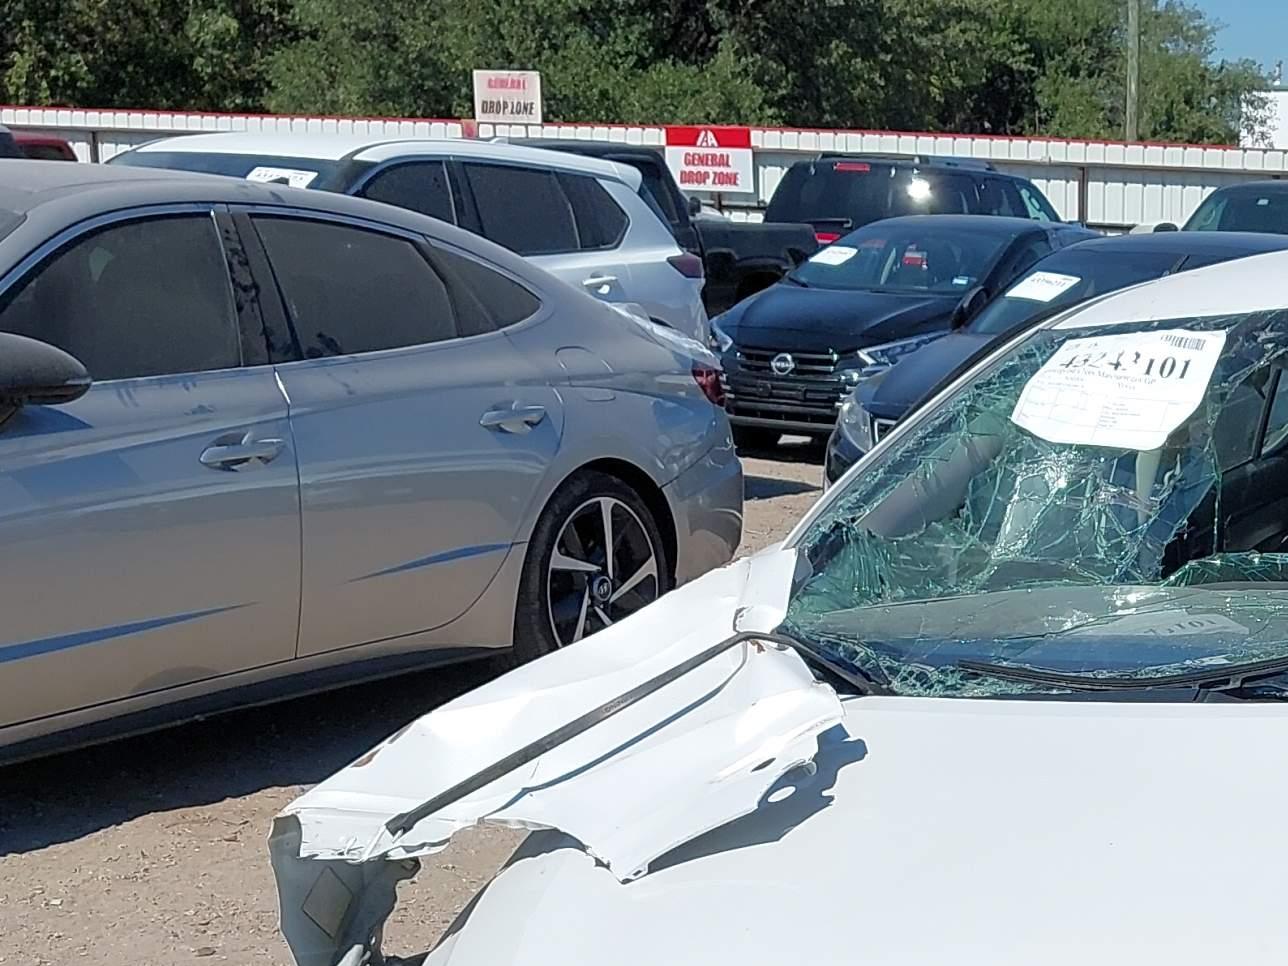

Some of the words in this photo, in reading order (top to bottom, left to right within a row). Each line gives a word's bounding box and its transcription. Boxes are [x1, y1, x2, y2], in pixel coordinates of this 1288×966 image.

[481, 100, 509, 115] DROP
[684, 152, 731, 168] GENERAL
[679, 170, 710, 185] DROP
[712, 171, 739, 186] ZONE
